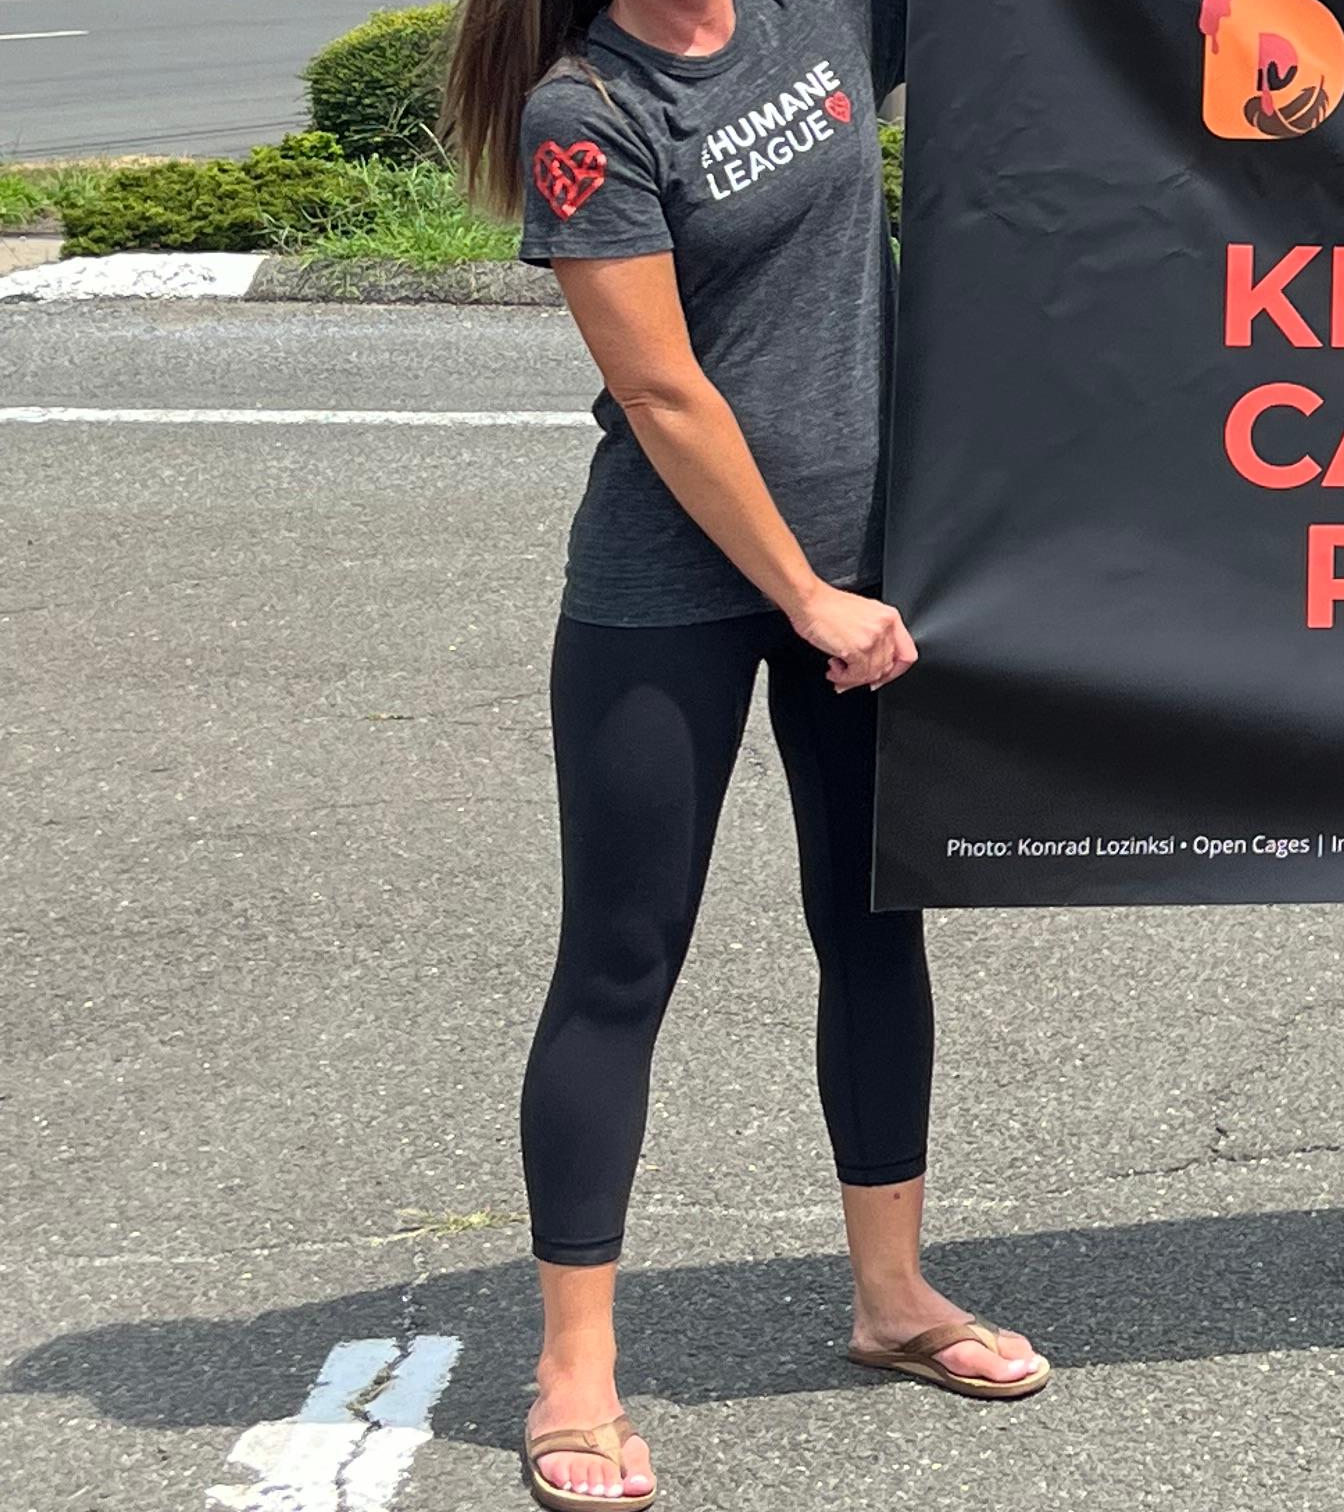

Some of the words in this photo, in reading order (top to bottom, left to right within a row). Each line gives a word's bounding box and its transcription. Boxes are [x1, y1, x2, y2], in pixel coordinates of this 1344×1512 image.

[706, 109, 836, 201] LEAGUE
[707, 60, 841, 162] HUMANE
[946, 838, 1012, 857] Photo:
[1017, 836, 1091, 856] Konrad
[1095, 835, 1175, 856] Lozinksi
[1192, 835, 1247, 859] Open
[1251, 835, 1310, 858] Cages
